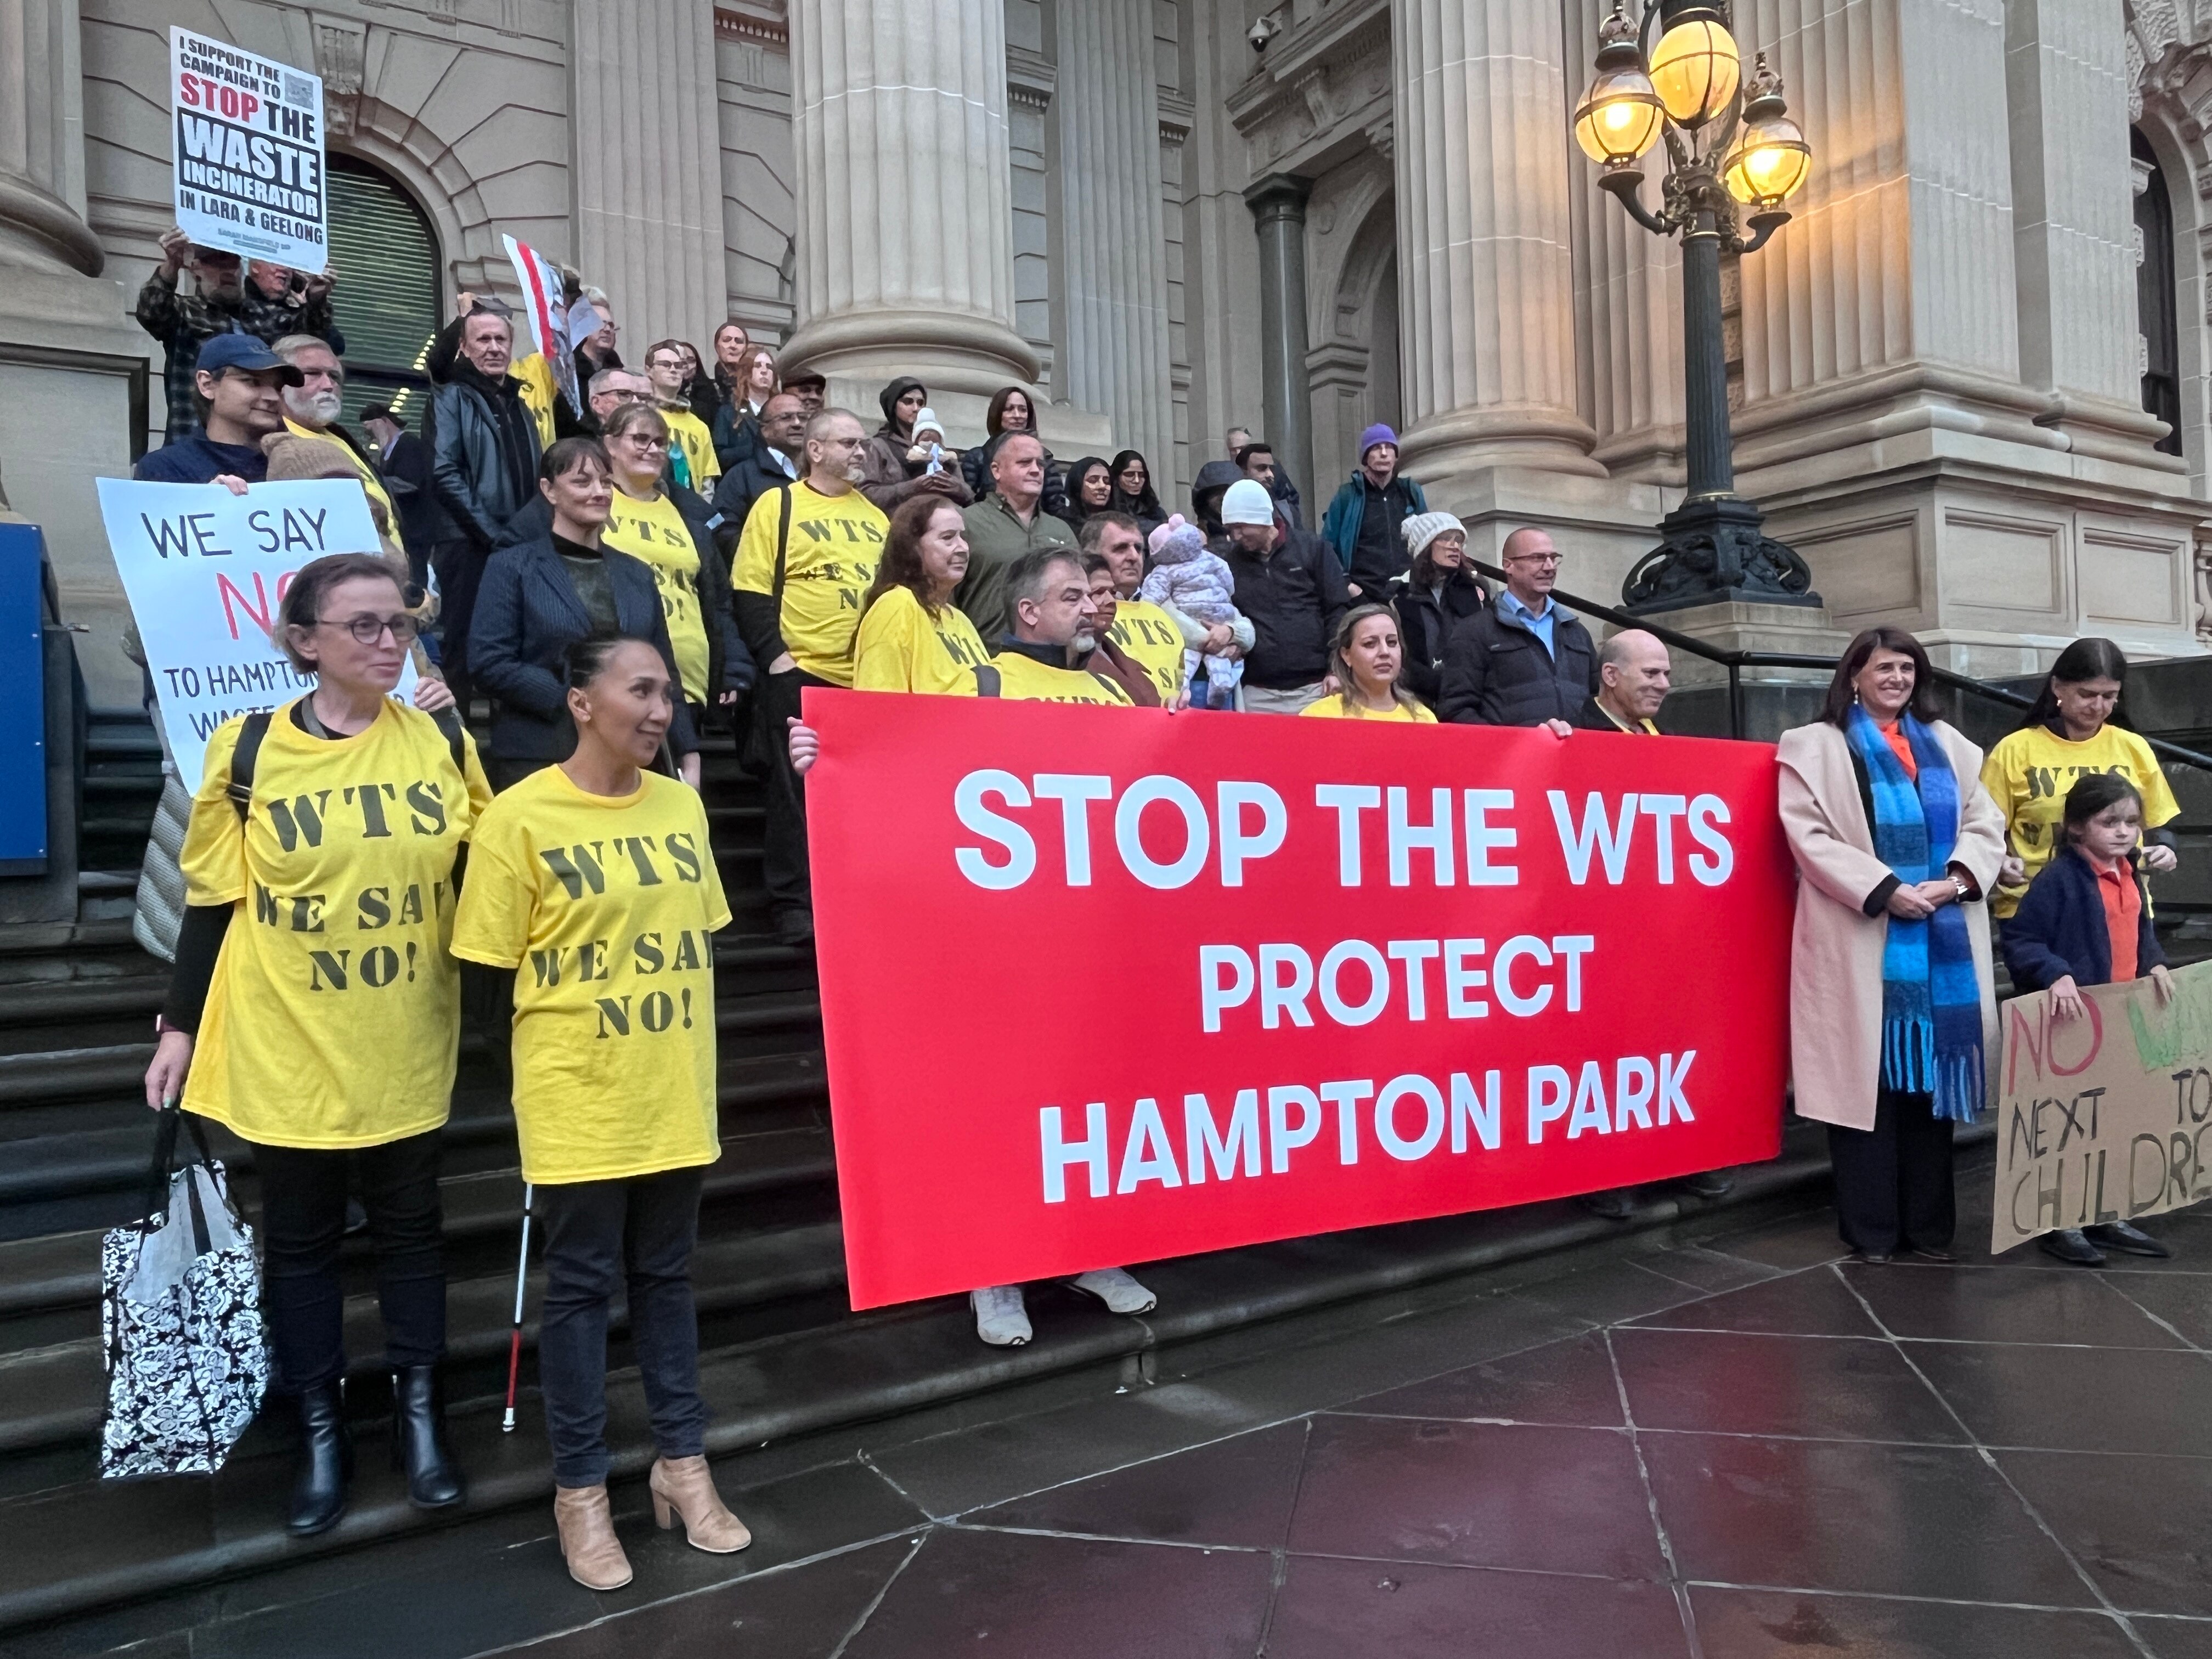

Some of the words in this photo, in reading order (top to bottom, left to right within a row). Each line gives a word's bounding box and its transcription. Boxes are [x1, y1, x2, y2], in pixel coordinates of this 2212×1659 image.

[179, 35, 184, 49] I
[188, 38, 252, 72] SUPPORT
[254, 63, 280, 83] THE
[180, 53, 259, 92] CAMPAIGN
[263, 81, 281, 99] TO
[180, 72, 258, 123] STOP
[263, 100, 317, 144] THE
[181, 112, 319, 193] WASTE
[183, 160, 319, 217] INCINERATOR
[180, 189, 196, 210] IN
[201, 195, 240, 223] LARA
[245, 207, 256, 227] &
[261, 212, 324, 245] GEELONG
[141, 512, 233, 558] WE
[248, 508, 326, 553] SAY
[797, 518, 883, 543] WTS
[216, 571, 297, 640] N
[1110, 618, 1175, 645] WTS
[163, 667, 200, 698] TO
[267, 780, 447, 852] WTS
[953, 769, 1288, 890] STOP
[1316, 784, 1519, 887] THE
[1547, 790, 1734, 887] WTS
[540, 833, 701, 900] WTS
[255, 878, 325, 932] WE
[308, 941, 417, 991] NO!
[529, 939, 608, 988] WE
[1199, 935, 1594, 1032] PROTECT
[594, 987, 692, 1039] NO!
[2008, 987, 2103, 1097] NO
[1039, 1069, 1501, 1204] HAMPTON
[1527, 1049, 1697, 1145] PARK
[2008, 1087, 2106, 1171] NEXT
[2172, 1067, 2212, 1124] TO
